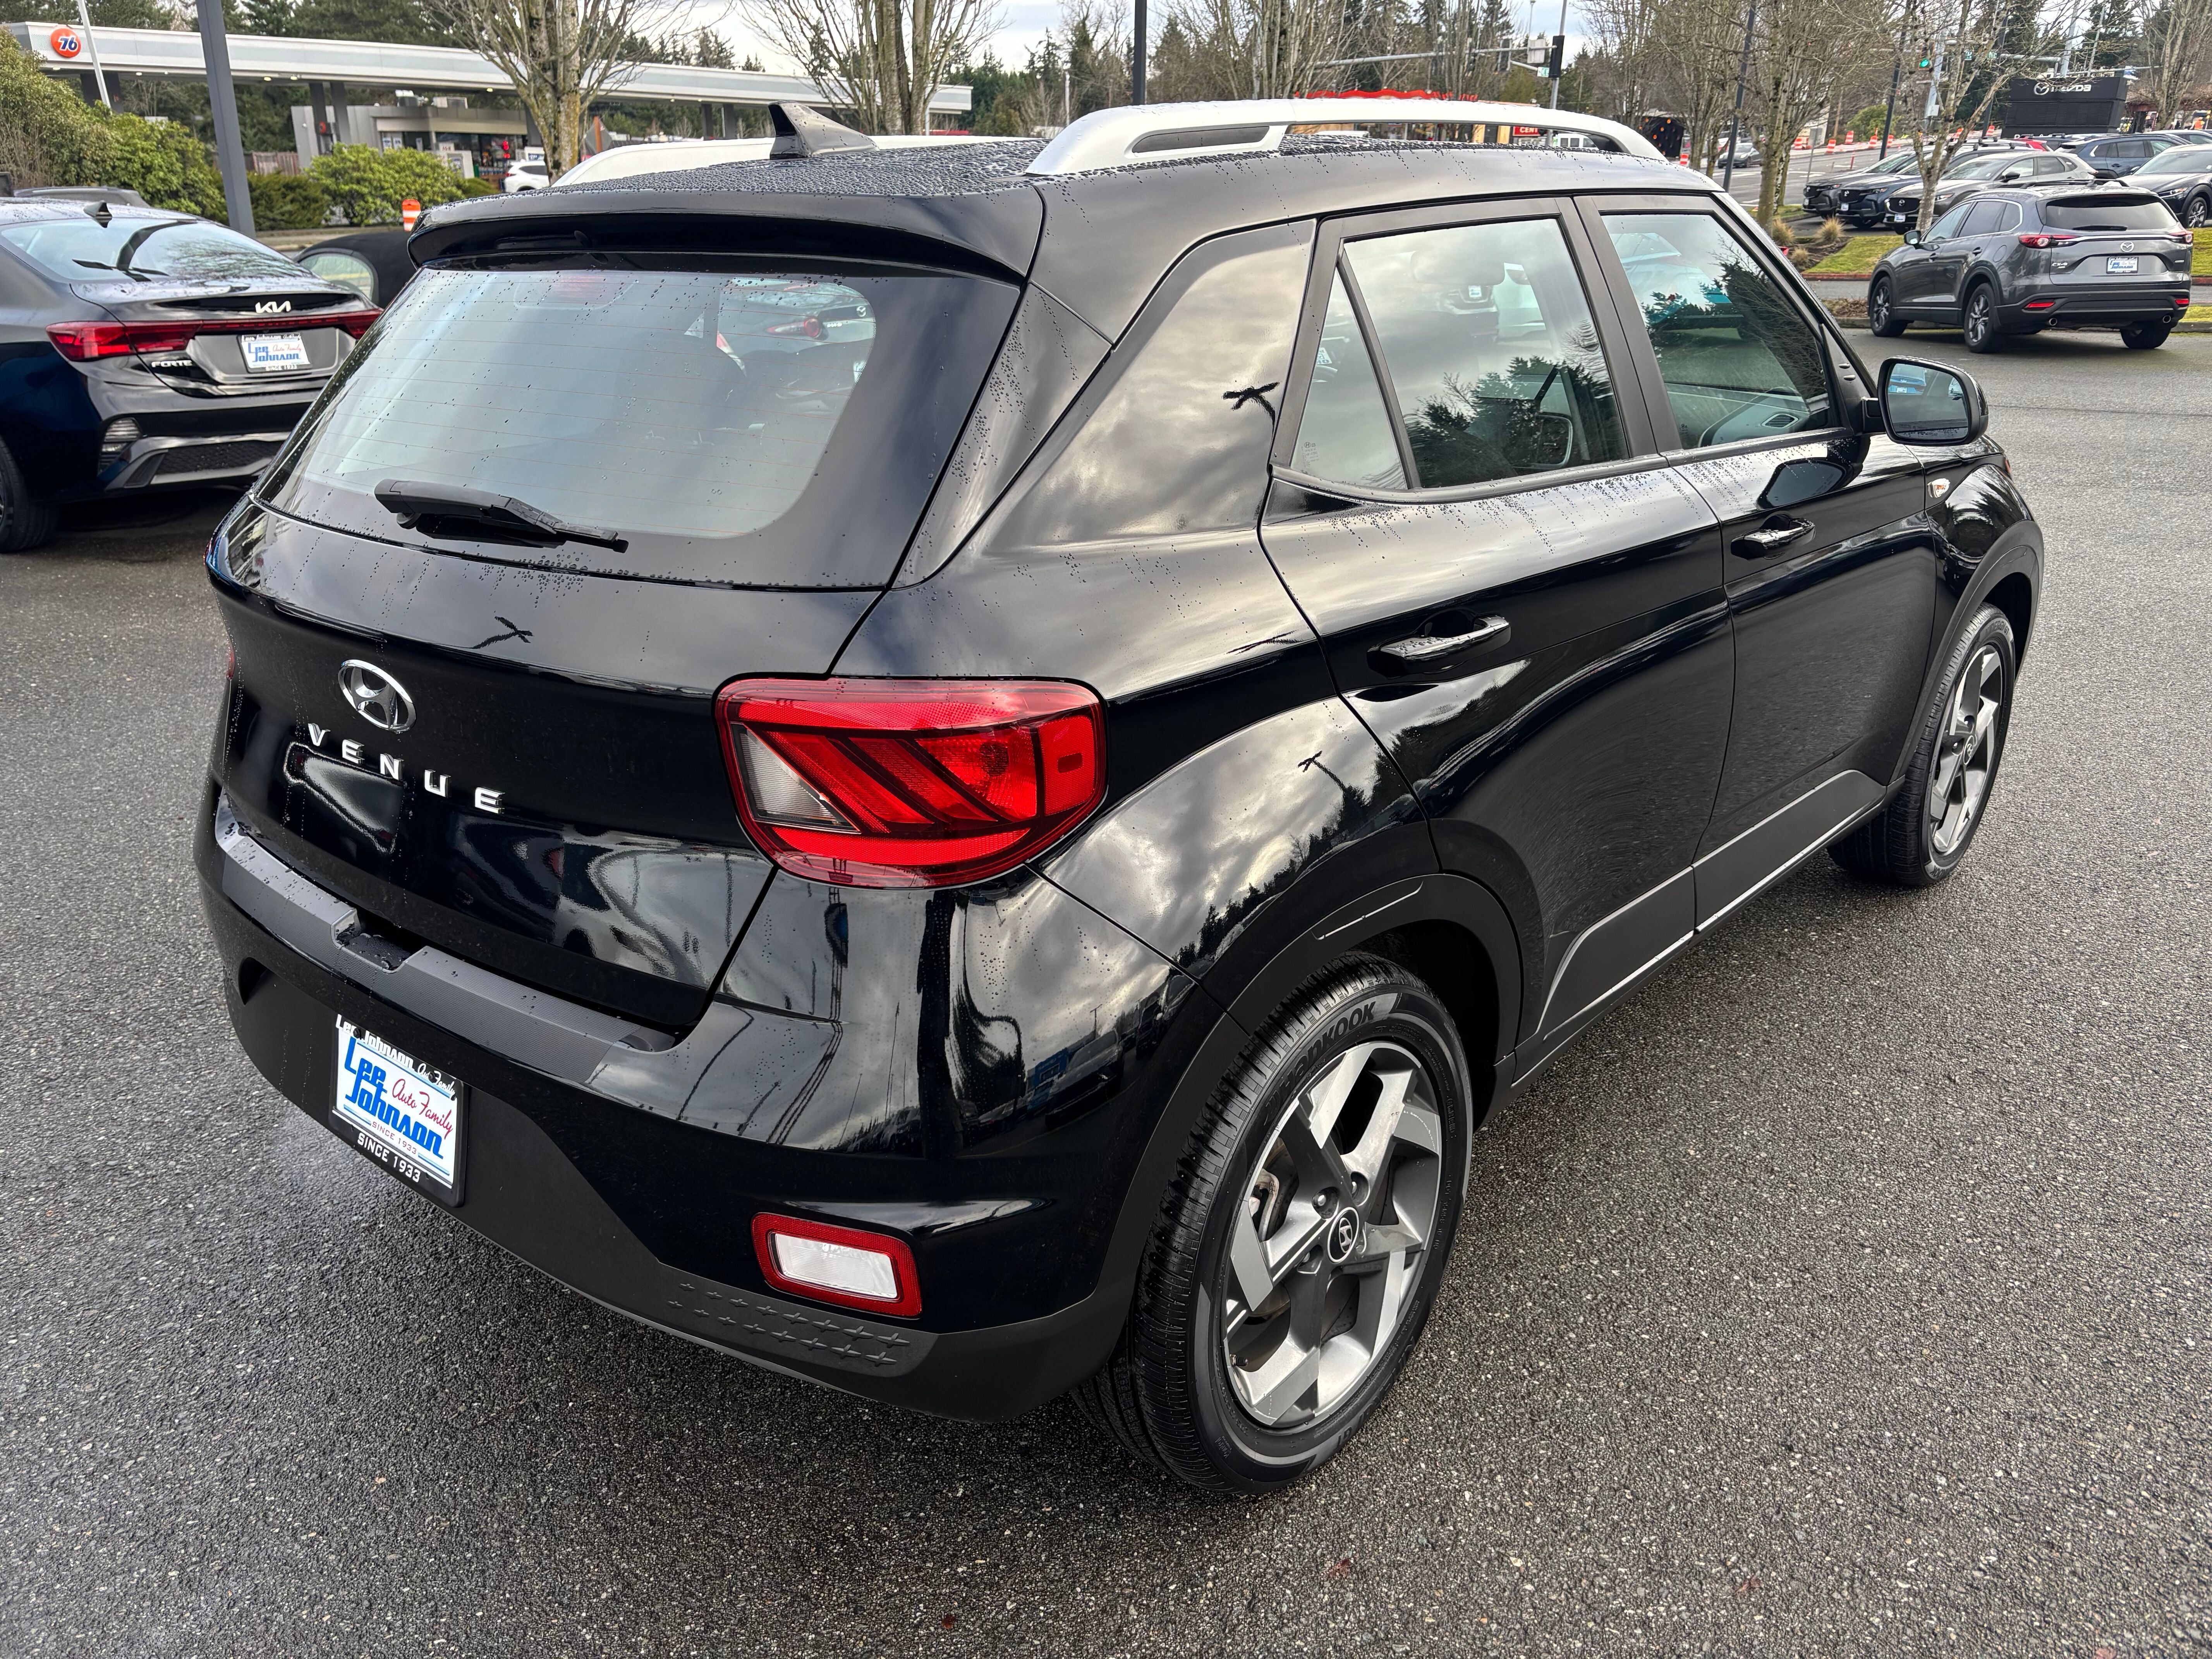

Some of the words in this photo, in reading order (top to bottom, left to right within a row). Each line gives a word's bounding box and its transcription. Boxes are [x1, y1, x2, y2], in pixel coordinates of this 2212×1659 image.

[58, 35, 78, 52] 76
[255, 301, 292, 314] KIA
[151, 359, 193, 368] FORTE
[307, 722, 506, 815] VENUE
[344, 1036, 387, 1084] Lee
[361, 1030, 415, 1071] Johnson
[345, 1075, 444, 1160] Johnson
[392, 1078, 417, 1109] Auto
[419, 1091, 453, 1140] Family
[357, 1132, 388, 1163] SINCE
[393, 1155, 421, 1183] 1933
[372, 1121, 395, 1141] SINCE
[398, 1137, 417, 1155] 1933
